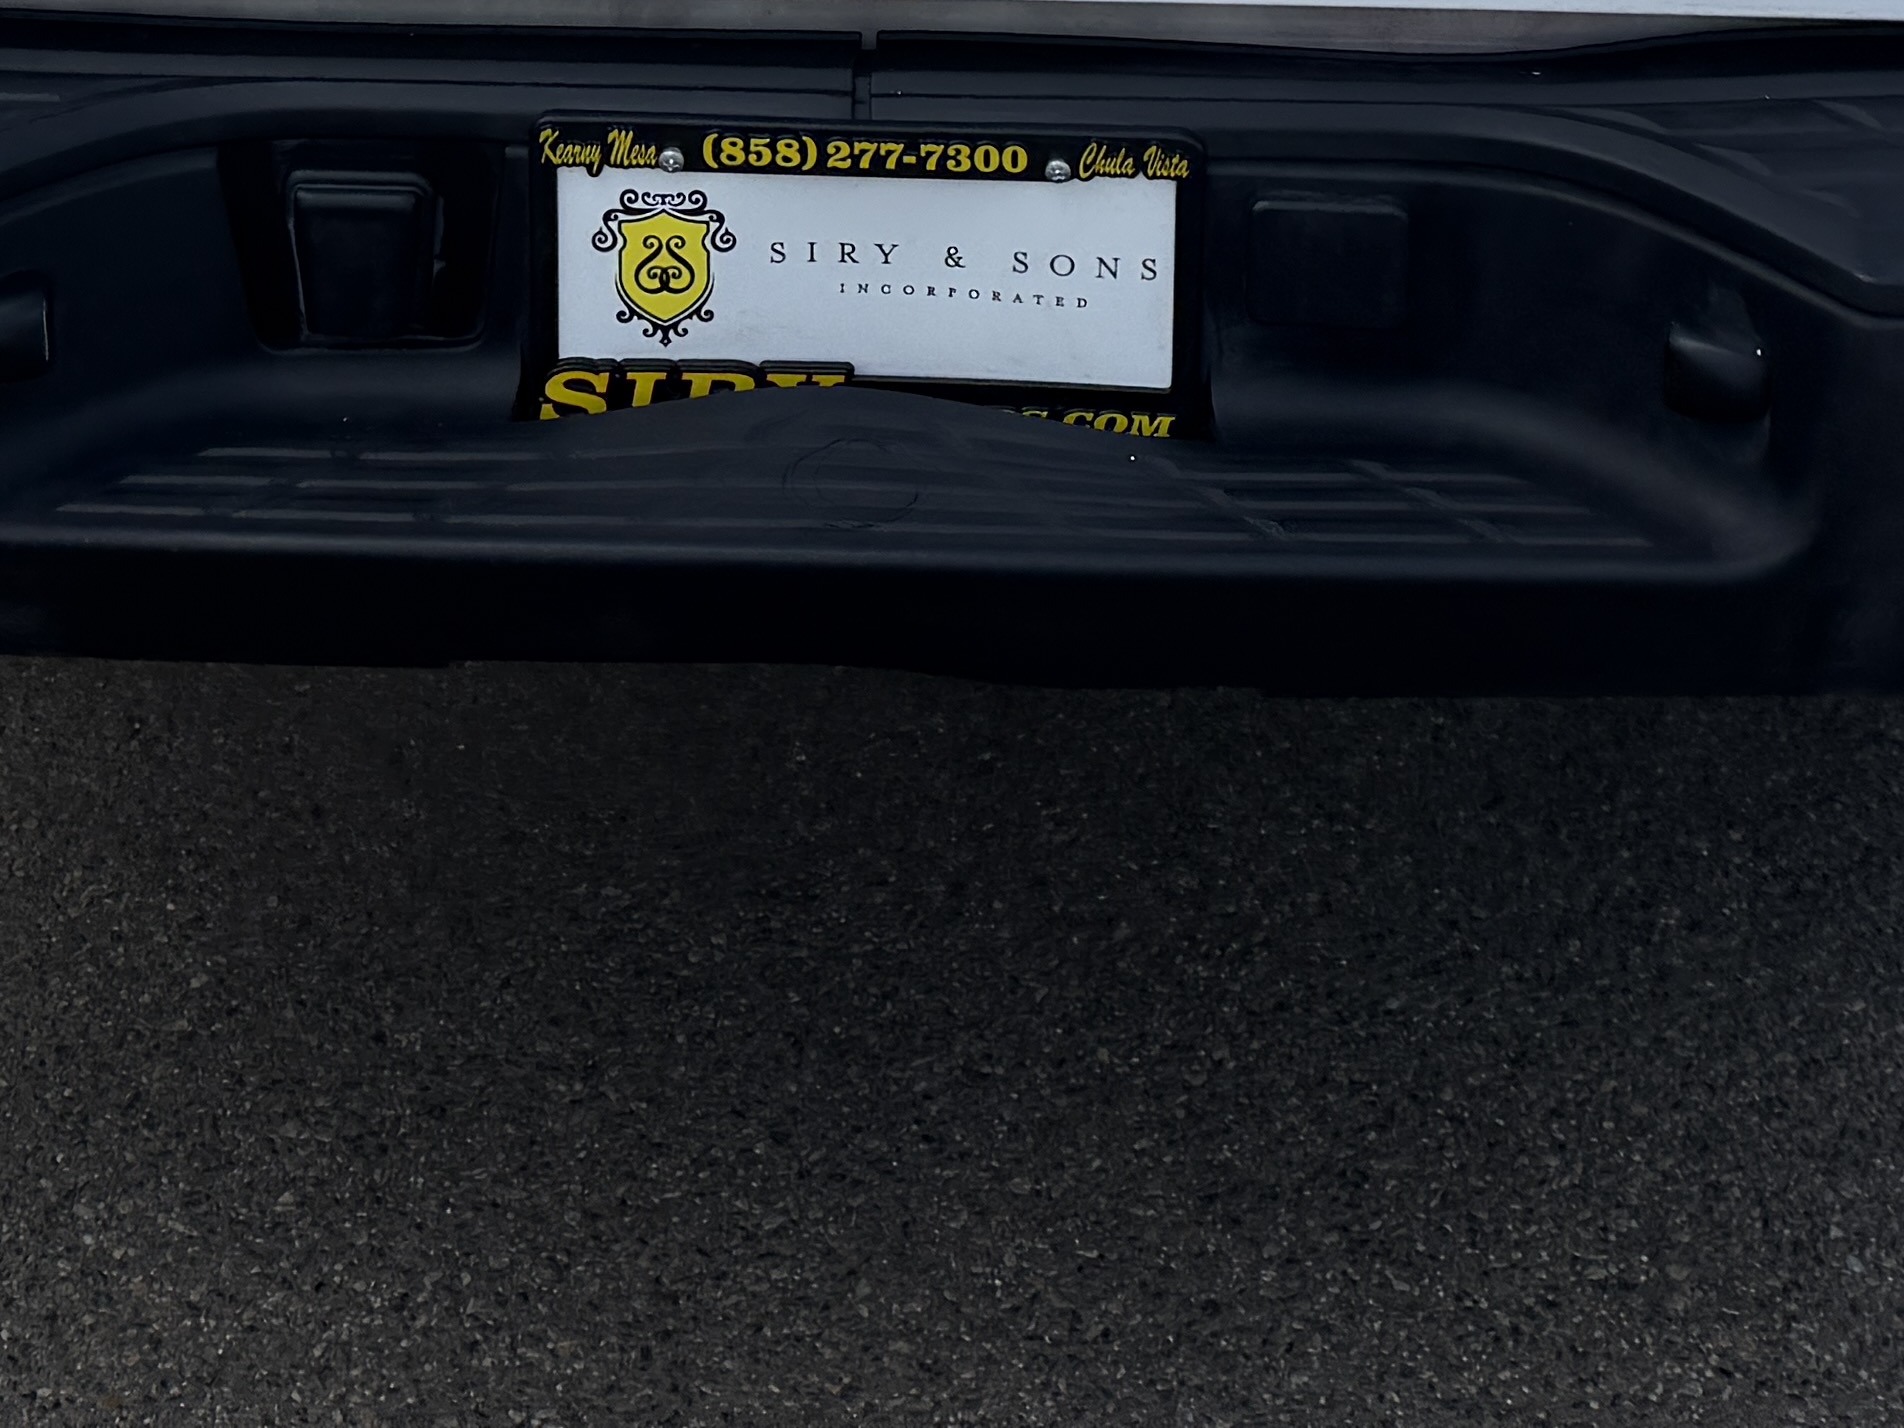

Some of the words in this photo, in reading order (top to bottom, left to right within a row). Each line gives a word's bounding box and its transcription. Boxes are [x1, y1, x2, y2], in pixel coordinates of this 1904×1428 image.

[539, 128, 603, 175] Kearny
[607, 128, 659, 167] Mesa
[703, 133, 818, 171] (858)
[826, 140, 1028, 173] 277-7300
[1078, 142, 1135, 179] Chula
[1143, 145, 1191, 179] Vista
[769, 241, 900, 266] SIRY
[944, 245, 966, 269] &
[1012, 250, 1160, 282] SONS
[839, 282, 1090, 309] INCORPORATED
[540, 370, 846, 421] SI
